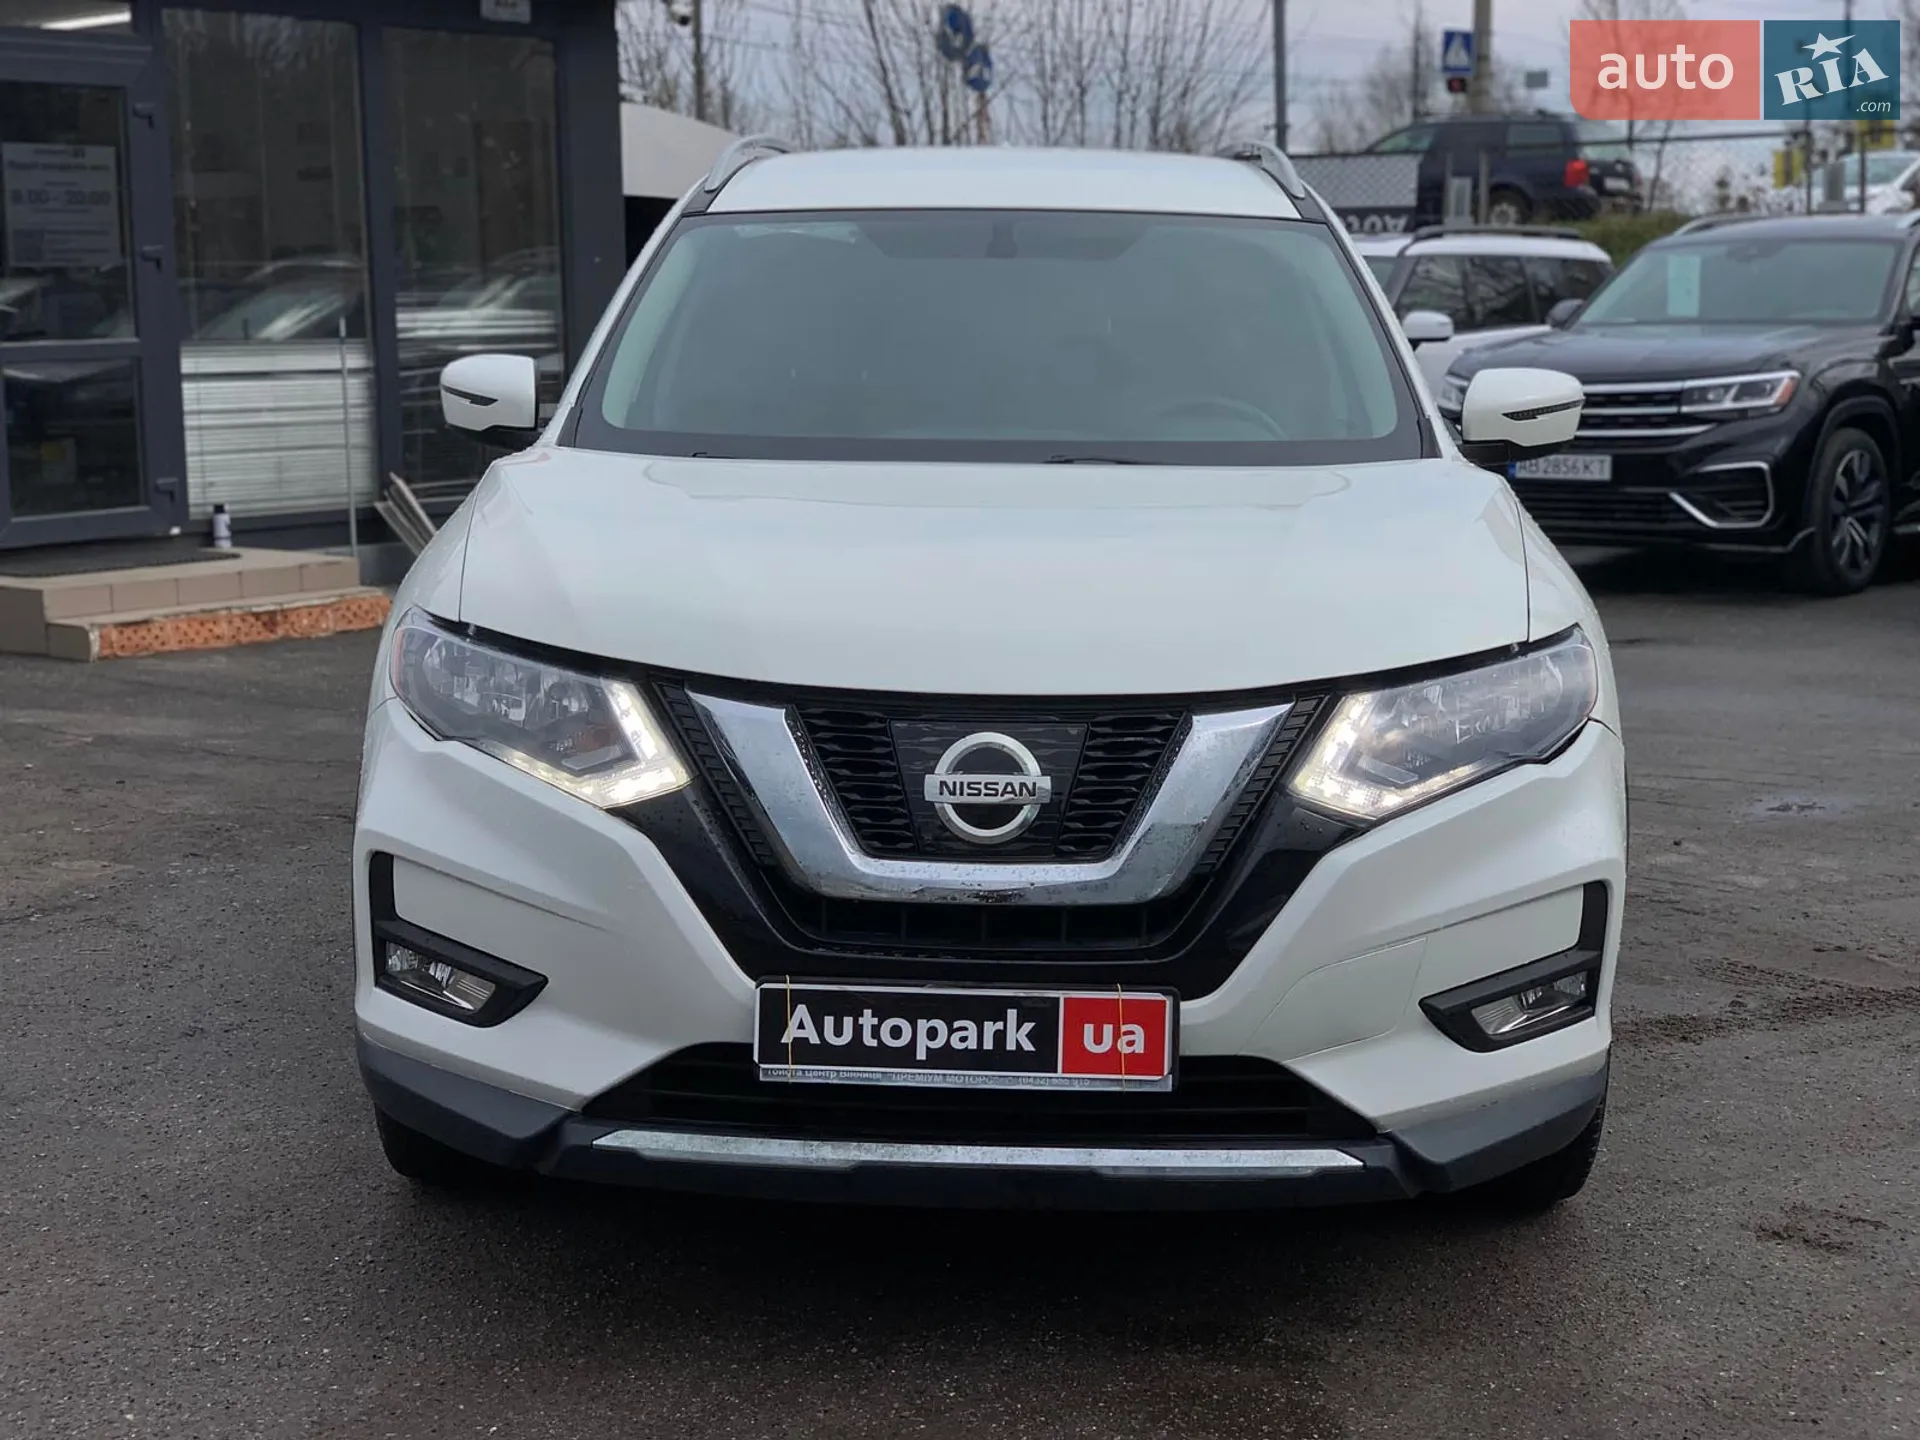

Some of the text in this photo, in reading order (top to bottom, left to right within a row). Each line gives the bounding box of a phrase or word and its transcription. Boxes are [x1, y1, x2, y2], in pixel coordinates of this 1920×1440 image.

[939, 779, 1037, 798] NISSAN
[781, 1003, 1145, 1061] Autopark ua
